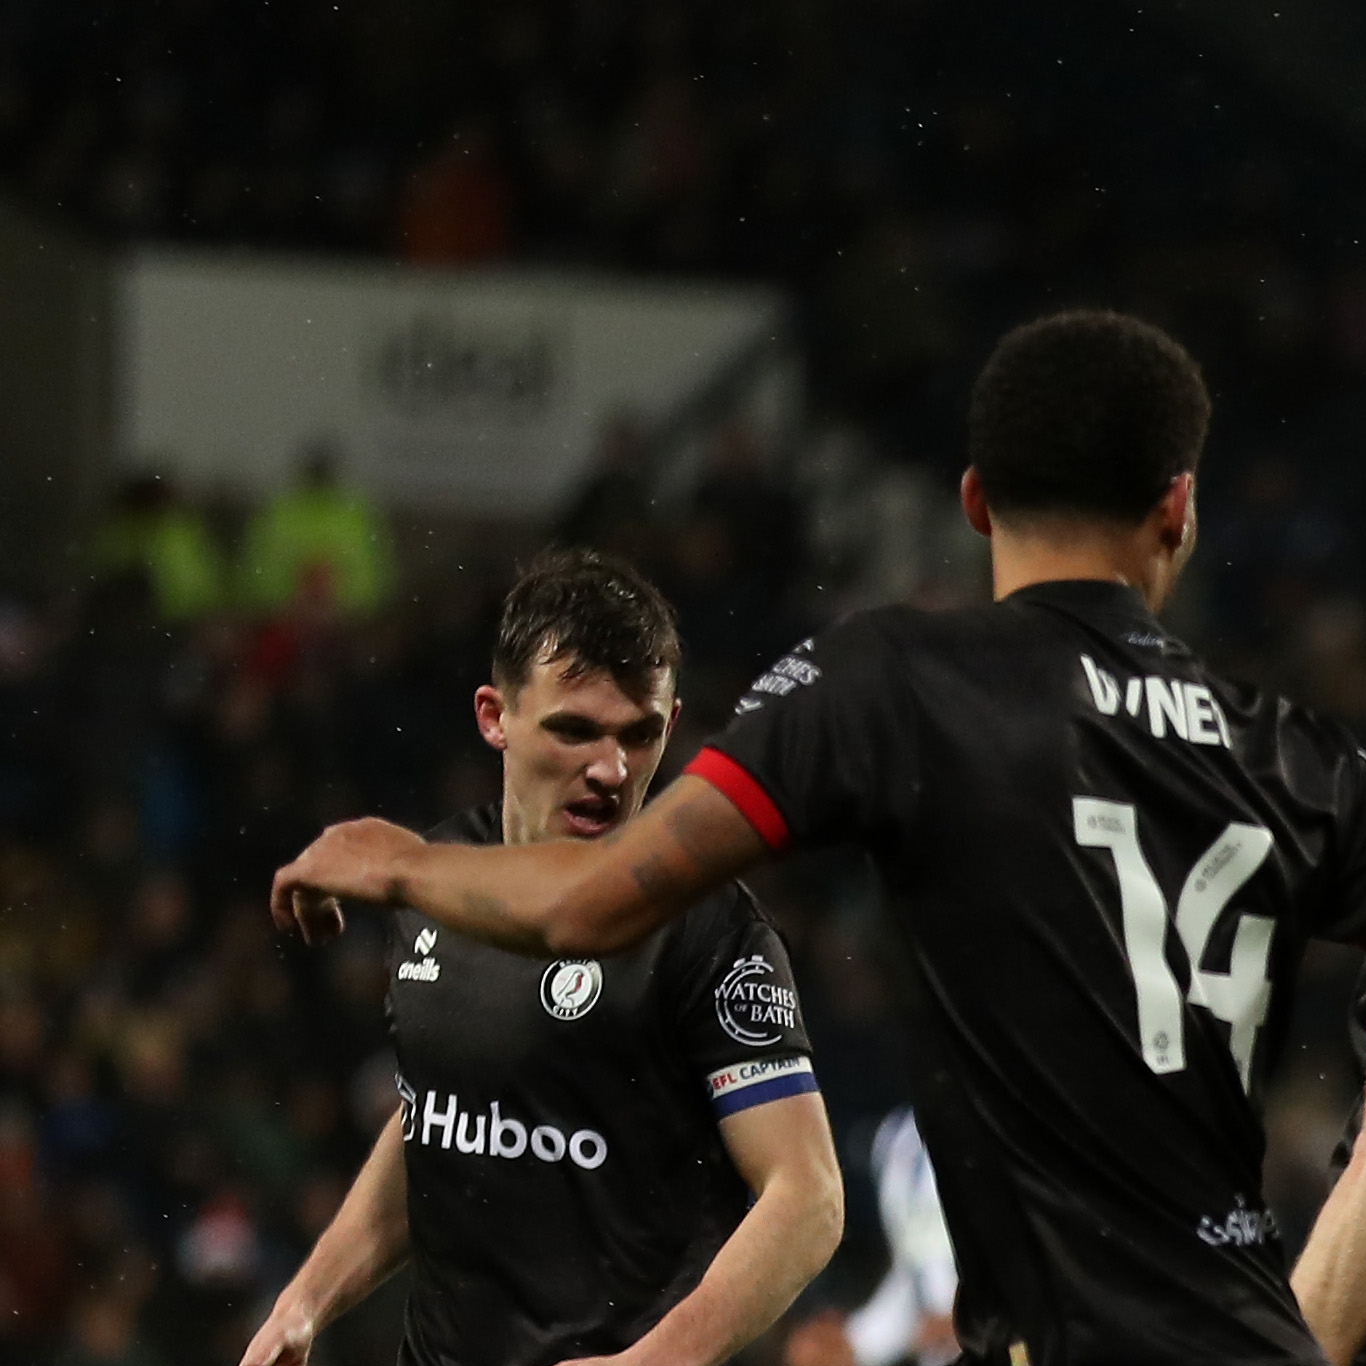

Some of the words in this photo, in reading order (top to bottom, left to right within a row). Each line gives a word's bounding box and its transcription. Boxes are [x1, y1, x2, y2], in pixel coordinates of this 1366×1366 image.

[1071, 794, 1275, 1099] 14
[714, 982, 797, 1010] WATCHES
[751, 1004, 796, 1029] BATH
[712, 1072, 738, 1090] EFL
[421, 1090, 608, 1170] Huboo
